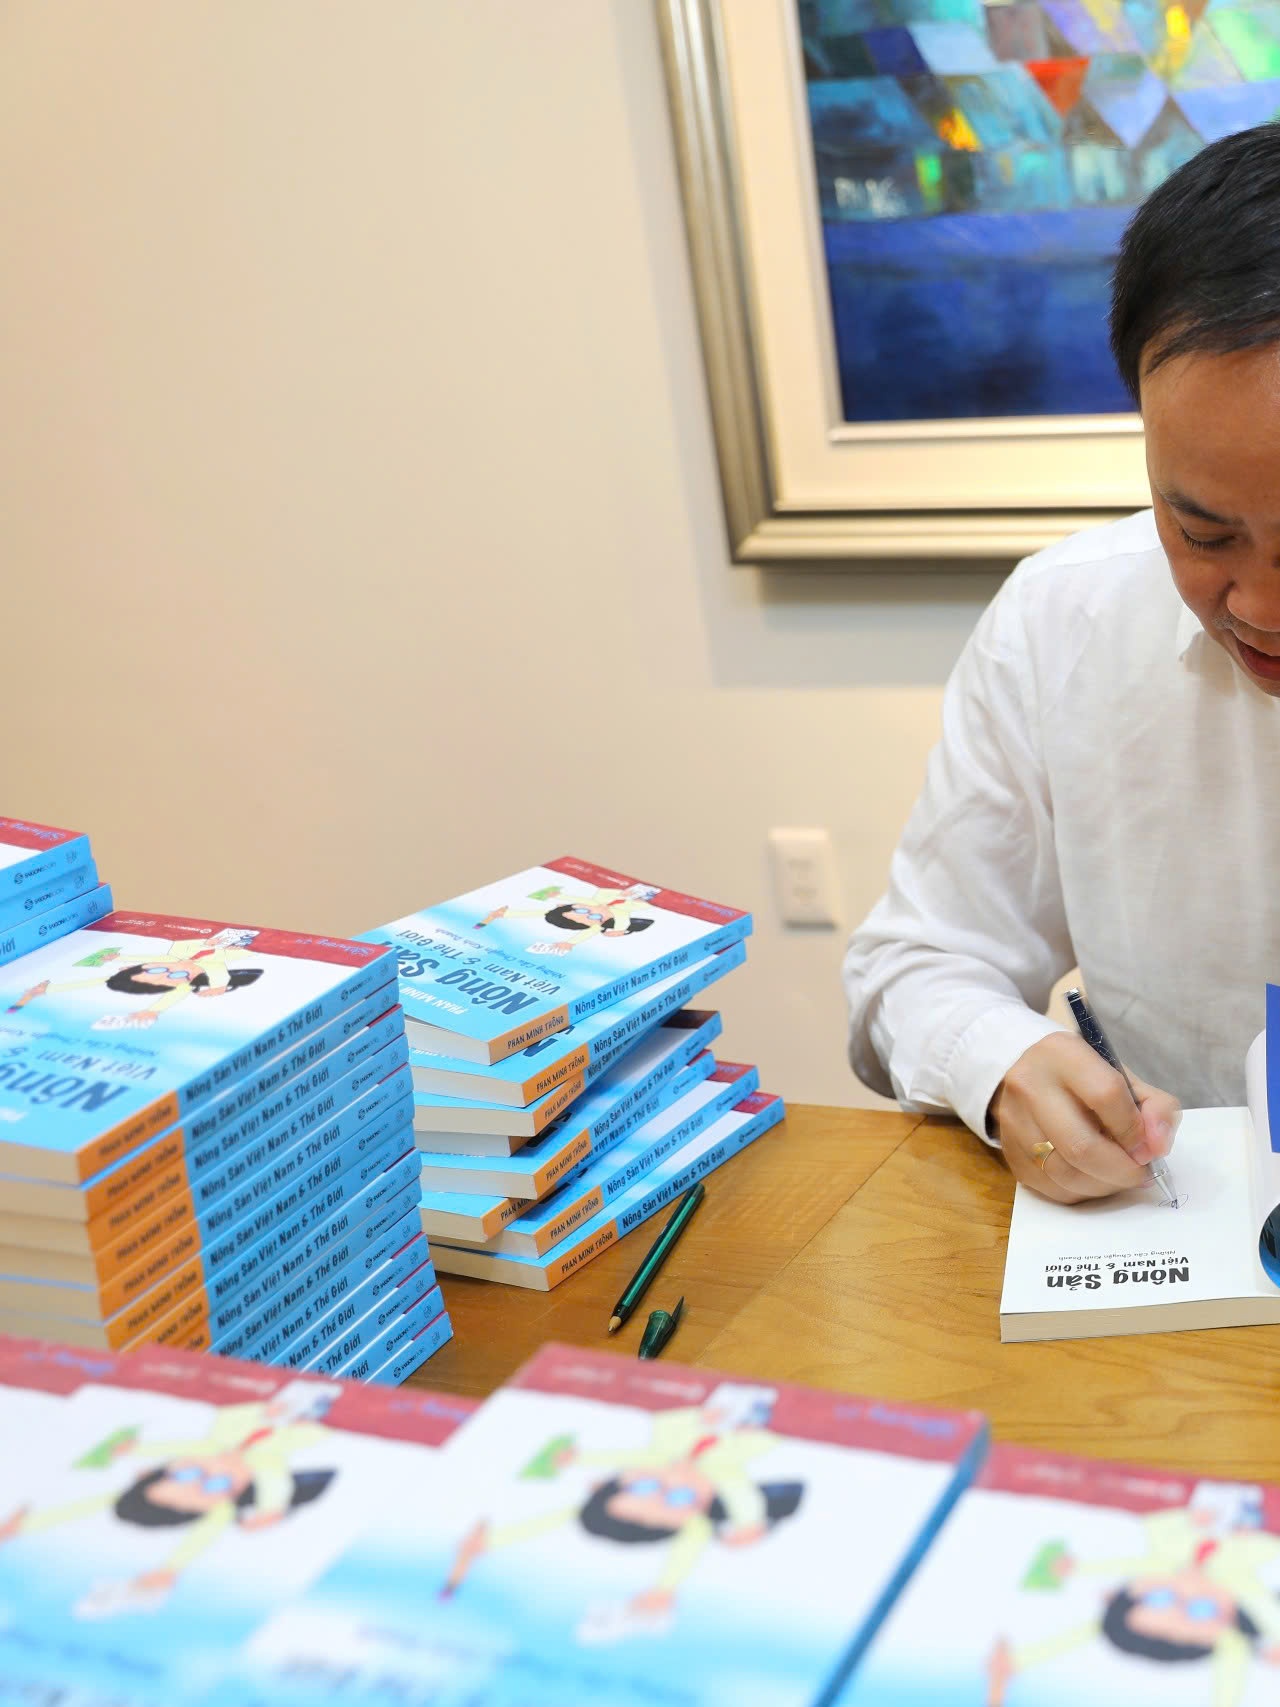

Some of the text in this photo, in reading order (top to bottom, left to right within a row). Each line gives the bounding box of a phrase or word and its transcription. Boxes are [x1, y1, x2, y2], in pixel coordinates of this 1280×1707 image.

[428, 944, 464, 960] Thế
[434, 968, 540, 1014] Nông
[484, 963, 525, 983] Nam
[524, 978, 560, 995] Việt
[575, 998, 596, 1016] Nông
[612, 982, 629, 996] Việt
[630, 972, 649, 987] Nam
[658, 960, 672, 972] Thế
[432, 998, 469, 1014] PHAN
[508, 1015, 564, 1049] PHAN MINH THÔNG
[594, 1036, 612, 1054] Nông
[626, 1016, 640, 1031] Việt
[642, 1006, 657, 1022] Nam
[537, 1055, 585, 1092] PHAN MINH THÔNG
[610, 1125, 625, 1139] Nam
[276, 1193, 296, 1216] Nam
[324, 1156, 341, 1177] Giới
[607, 1178, 626, 1195] Nông
[626, 1166, 639, 1180] Sản
[639, 1155, 653, 1169] Việt
[655, 1144, 670, 1159] Nam
[279, 1223, 300, 1246] Nam
[327, 1186, 343, 1208] Giới
[501, 1204, 516, 1220] PHAN
[550, 1198, 598, 1239] PHAN MINH THÔNG
[622, 1212, 642, 1228] Nông
[657, 1186, 671, 1203] Việt
[673, 1175, 690, 1191] Nam
[262, 1270, 281, 1292] Việt
[283, 1253, 304, 1277] Nam
[332, 1216, 348, 1237] Giới
[562, 1231, 612, 1273] PHAN MINH THÔNG
[1045, 1264, 1072, 1272] Giới
[1076, 1264, 1101, 1272] Thế
[1161, 1257, 1189, 1266] Việt
[263, 1300, 282, 1322] Việt
[284, 1283, 305, 1307] Nam
[315, 1260, 330, 1281] Thế
[332, 1245, 349, 1267] Giới
[1047, 1267, 1189, 1291] Nông Sản
[261, 1331, 280, 1356] Việt
[282, 1317, 304, 1339] Nam
[313, 1289, 330, 1312] Thế
[331, 1276, 348, 1299] Giới
[289, 1347, 311, 1368] Nam
[320, 1317, 337, 1340] Thế
[338, 1304, 355, 1326] Giới
[326, 1333, 361, 1371] Thế Giới
